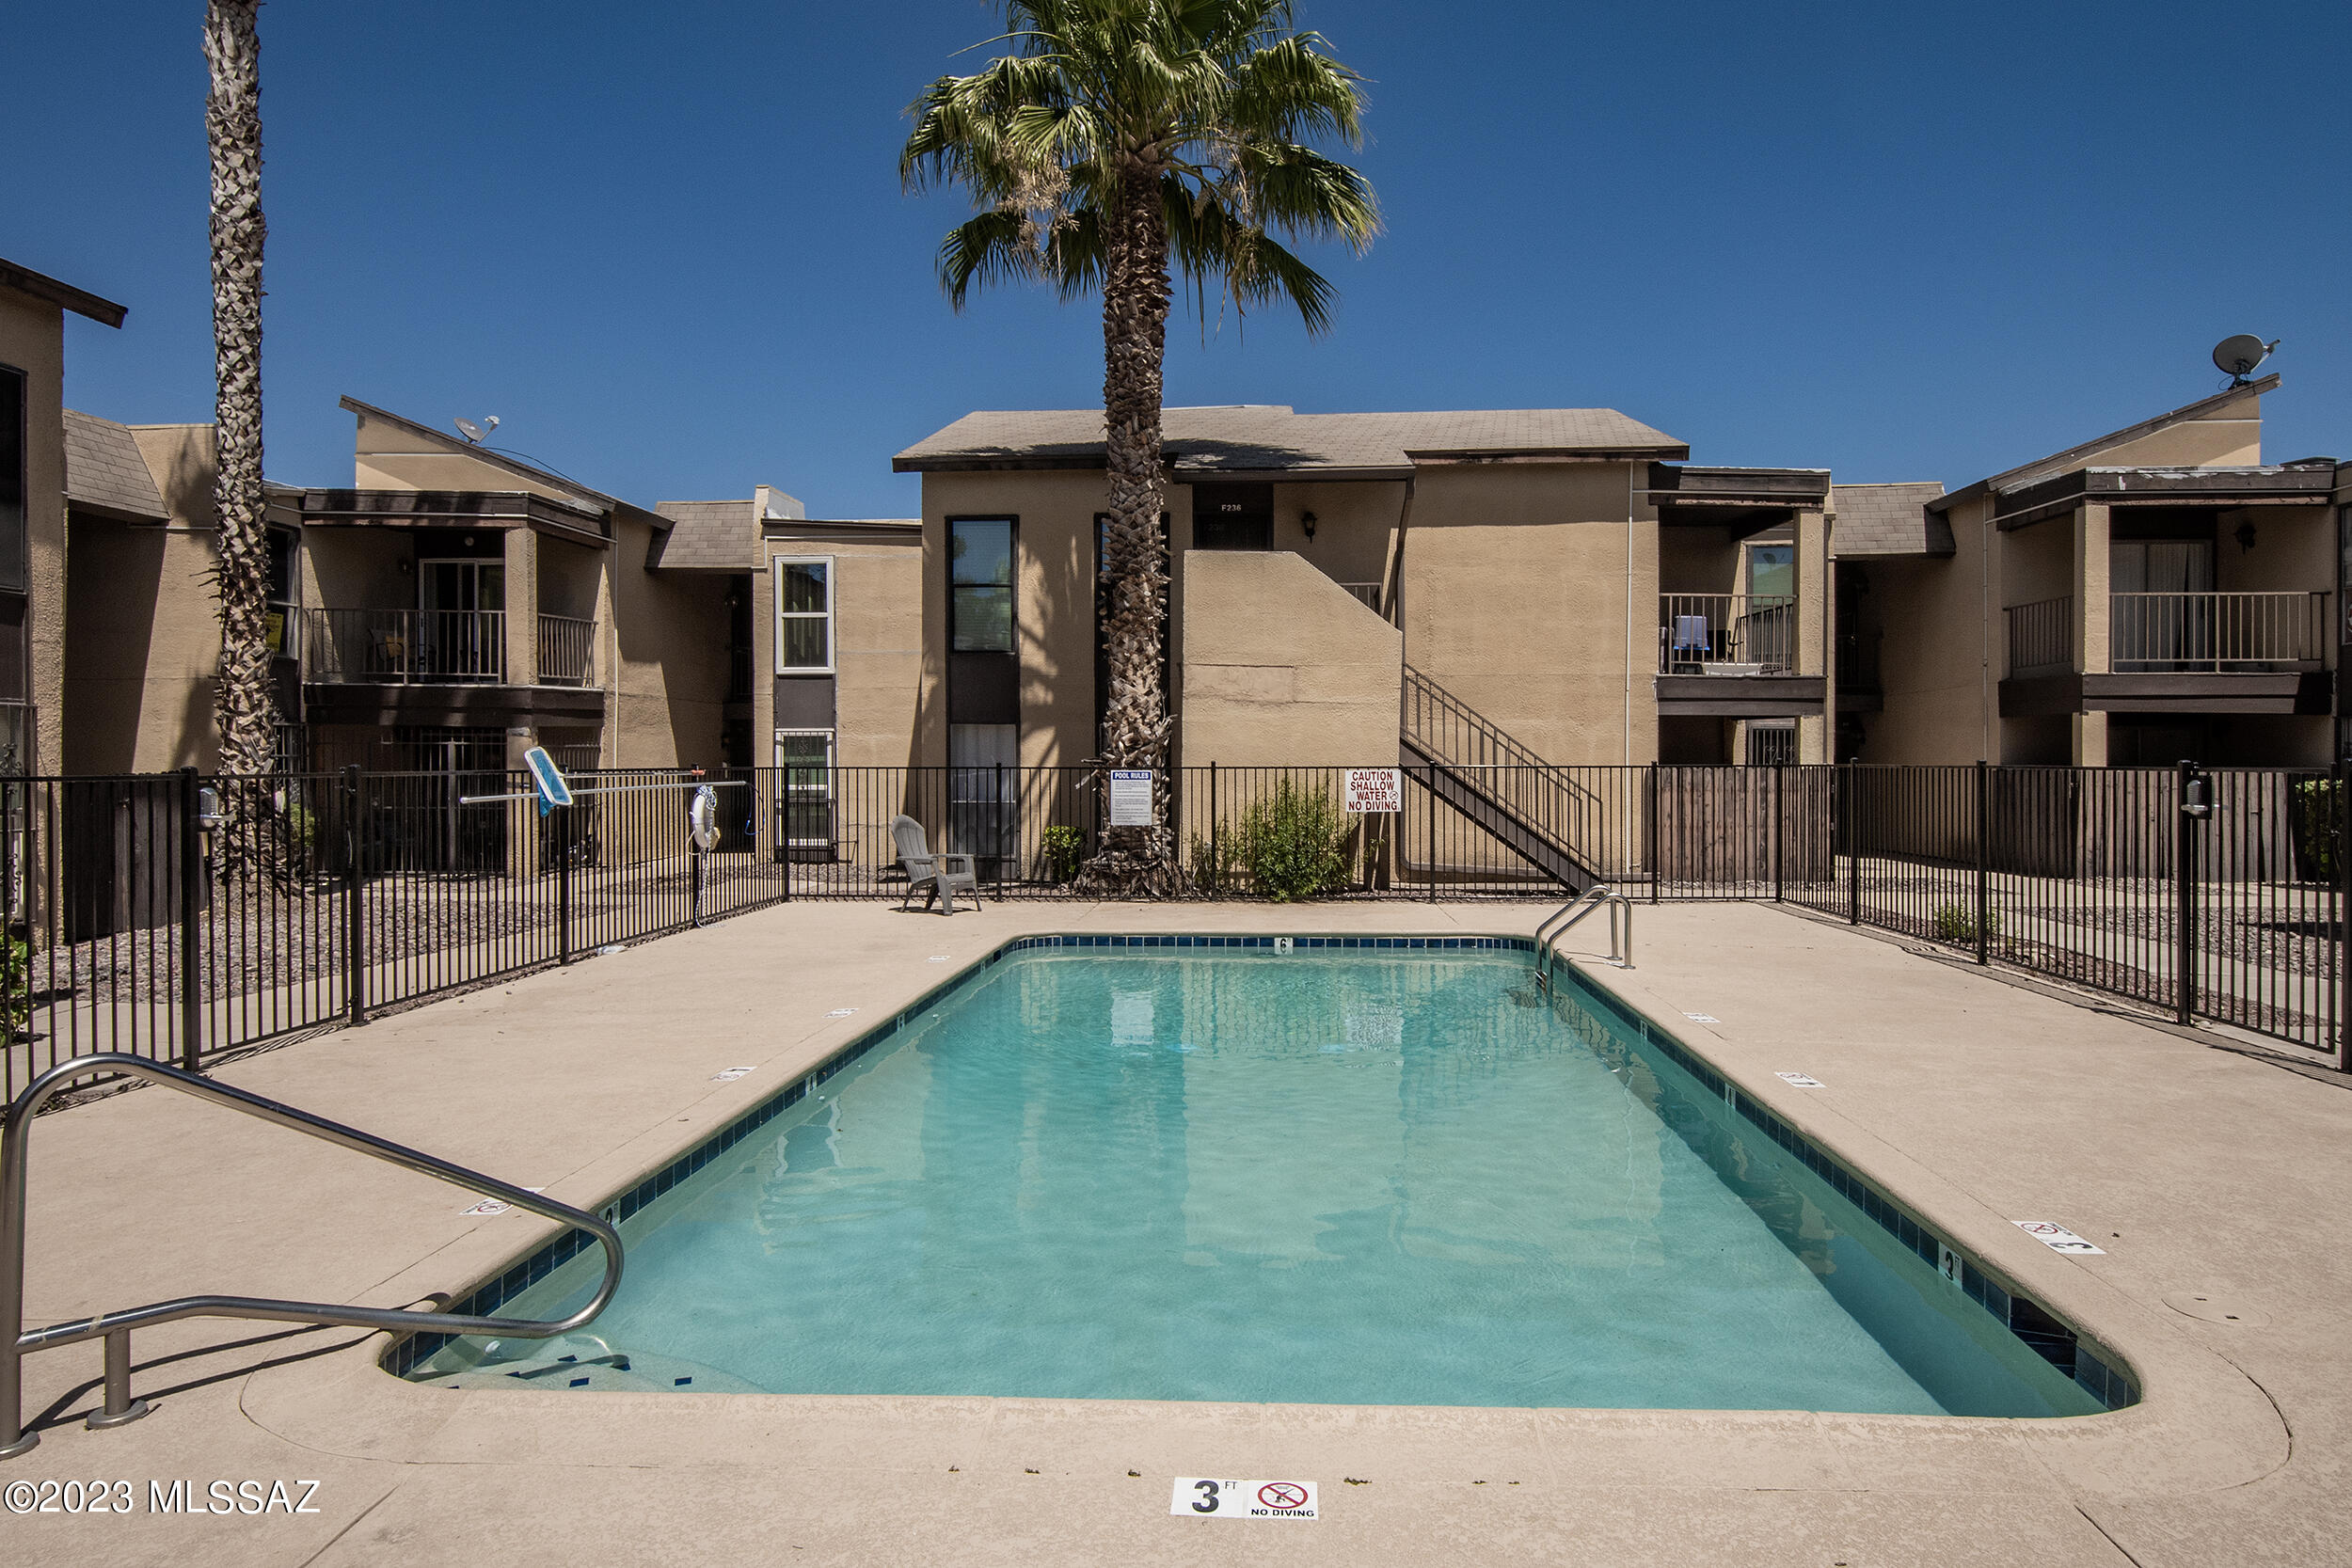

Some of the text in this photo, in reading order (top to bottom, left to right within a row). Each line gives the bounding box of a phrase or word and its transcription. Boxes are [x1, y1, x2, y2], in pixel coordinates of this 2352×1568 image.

[1352, 771, 1393, 781] CAUTION
[1350, 781, 1394, 791] SHALLOW
[1356, 791, 1388, 800] WATER
[1348, 800, 1398, 811] NO DIVING
[1945, 1250, 1954, 1280] 3
[1191, 1480, 1238, 1513] 3 FT
[1250, 1508, 1315, 1517] NO DIVING
